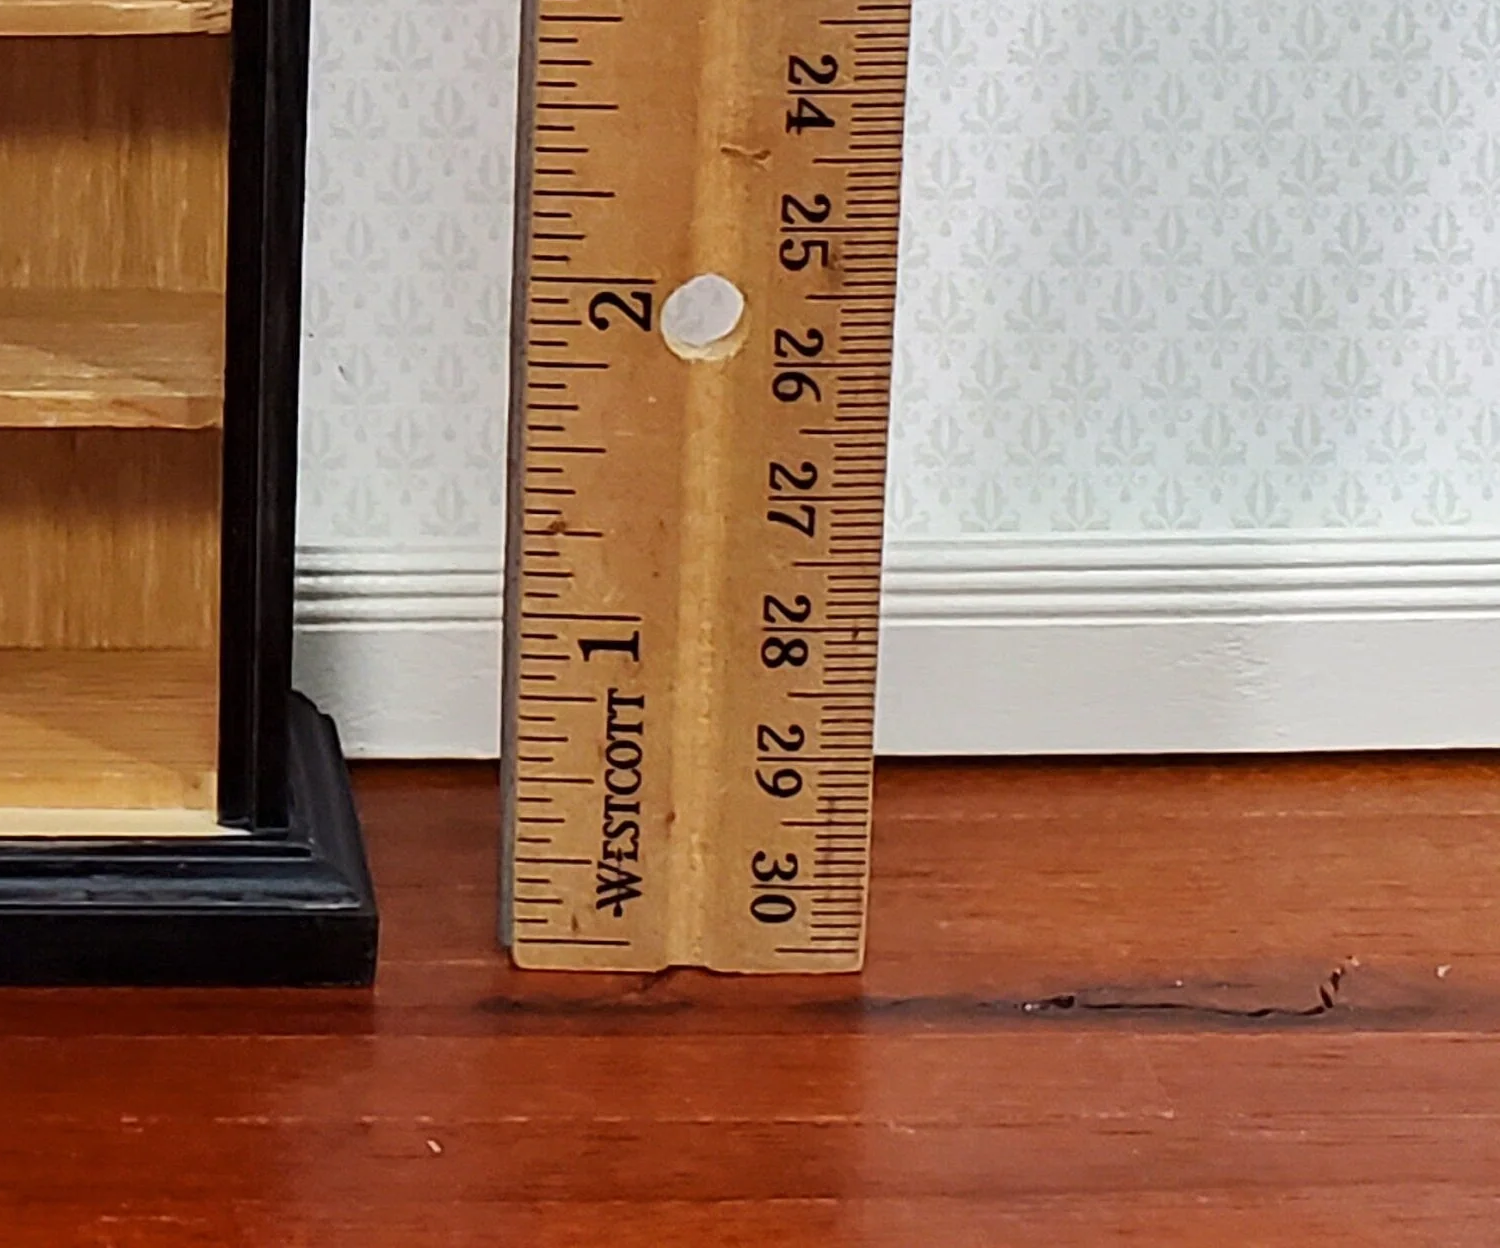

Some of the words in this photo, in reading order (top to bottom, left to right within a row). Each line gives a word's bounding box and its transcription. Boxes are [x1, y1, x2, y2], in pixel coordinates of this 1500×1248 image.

[785, 55, 838, 135] 24
[779, 194, 832, 271] 25
[588, 291, 653, 332] 2
[772, 328, 825, 403] 26
[767, 461, 818, 538] 27
[577, 629, 641, 662] 1
[760, 594, 812, 670] 28
[755, 723, 806, 799] 29
[595, 687, 646, 917] WESTCOTT
[750, 850, 799, 923] 30
